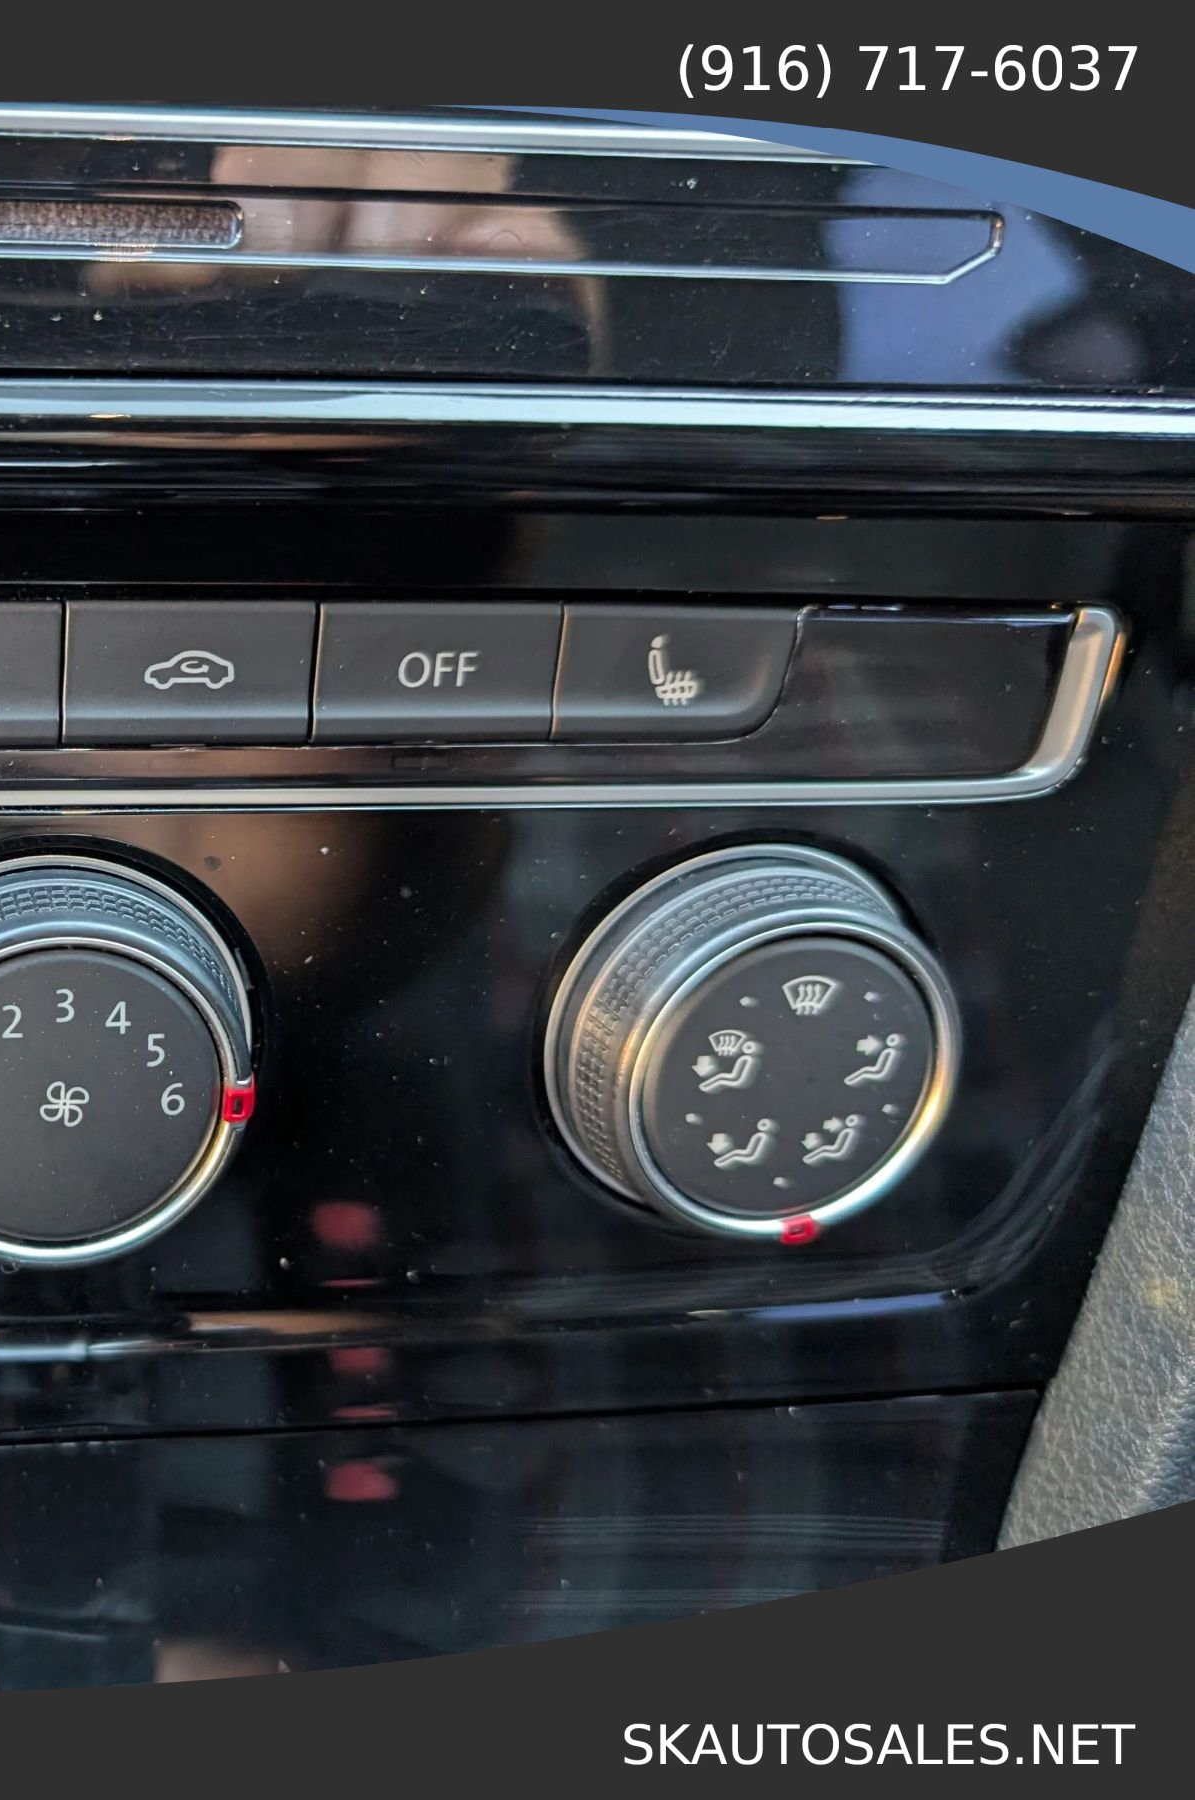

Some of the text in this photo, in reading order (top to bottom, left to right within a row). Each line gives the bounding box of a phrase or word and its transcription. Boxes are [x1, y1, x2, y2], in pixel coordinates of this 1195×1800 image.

[397, 651, 479, 689] OFF
[1, 1004, 24, 1039] 2
[55, 988, 76, 1024] 3
[104, 1000, 132, 1035] 4
[146, 1033, 166, 1068] 5
[160, 1082, 186, 1116] 6
